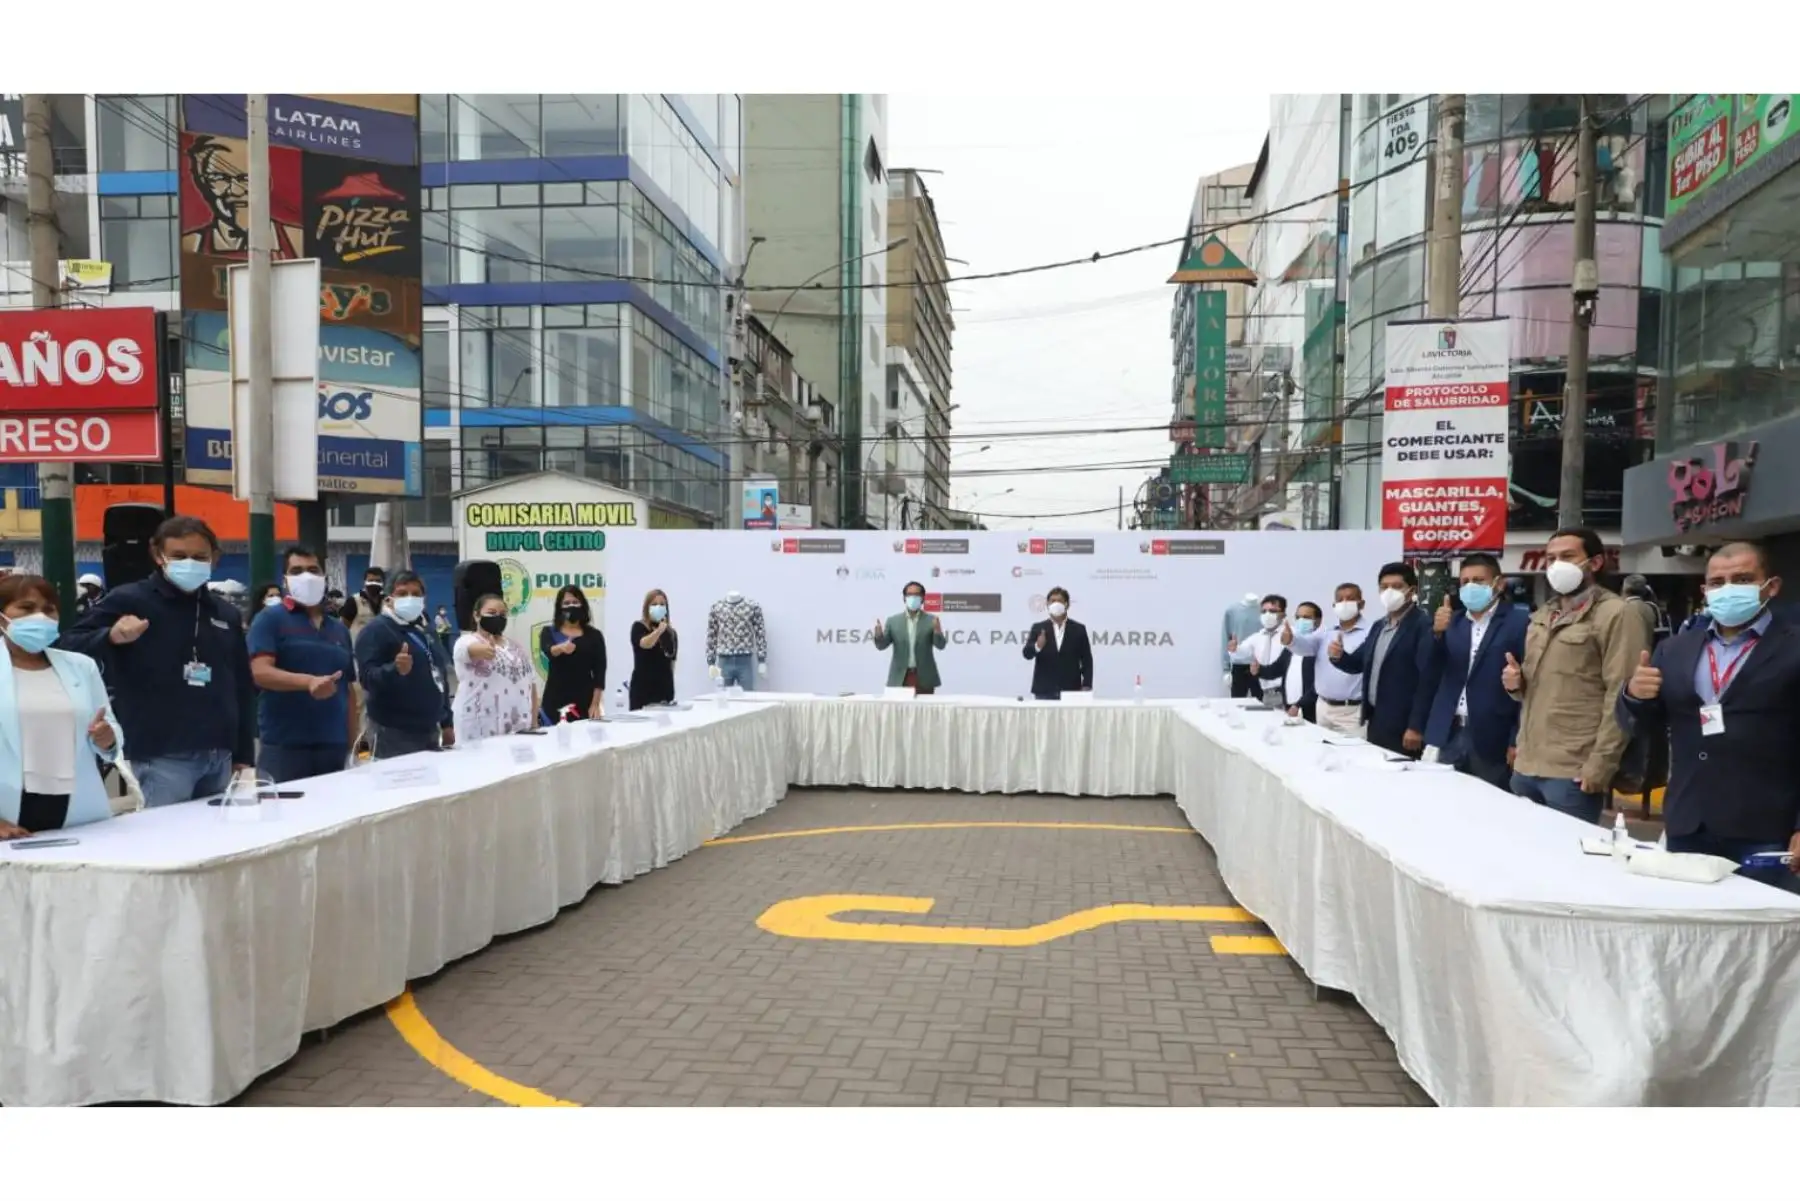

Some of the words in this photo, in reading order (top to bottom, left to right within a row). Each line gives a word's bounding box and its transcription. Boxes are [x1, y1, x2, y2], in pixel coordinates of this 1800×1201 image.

[274, 107, 361, 134] LATAM
[274, 126, 361, 149] AIRLINES
[1385, 132, 1419, 158] 409
[316, 198, 410, 240] Pizza
[333, 226, 405, 253] Hut
[1405, 385, 1488, 397] PROTOCOLO
[1393, 399, 1411, 409] DE
[1414, 394, 1500, 407] SALUBRIDAD
[1436, 420, 1456, 431] EL
[0, 417, 111, 452] RESO
[1387, 433, 1505, 448] COMERCIANTE
[1397, 450, 1440, 461] DEBE
[1444, 448, 1494, 460] USAR:
[1386, 485, 1504, 500] MASCARILLA,
[467, 502, 575, 526] COMISARIA
[576, 502, 637, 526] MOVIL
[1398, 501, 1486, 513] GUANTES,
[1402, 515, 1469, 527] MANDIL
[1472, 515, 1485, 526] Y
[486, 531, 542, 551] DIVPOL
[543, 531, 606, 551] CENTRO
[1412, 529, 1474, 541] GORRO
[816, 629, 875, 644] MESA
[1091, 629, 1174, 646] MARRA
